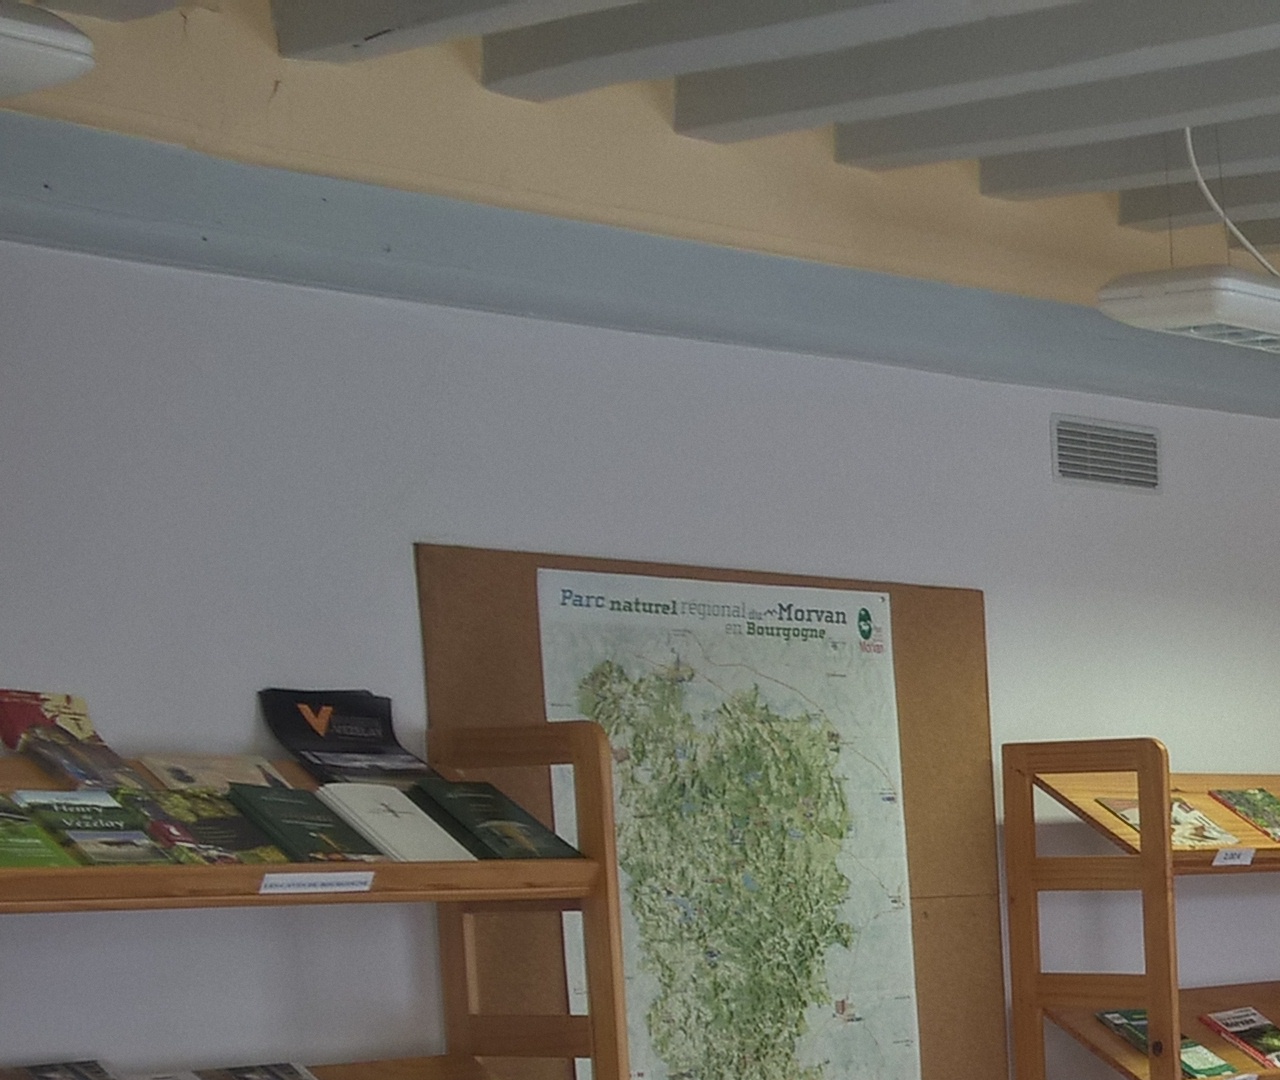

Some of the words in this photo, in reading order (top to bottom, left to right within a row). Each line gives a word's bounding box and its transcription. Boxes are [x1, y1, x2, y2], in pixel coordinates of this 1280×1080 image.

[560, 588, 604, 609] Parc
[609, 600, 678, 616] naturel
[778, 603, 847, 625] Morvan
[746, 621, 826, 641] Bourgogne
